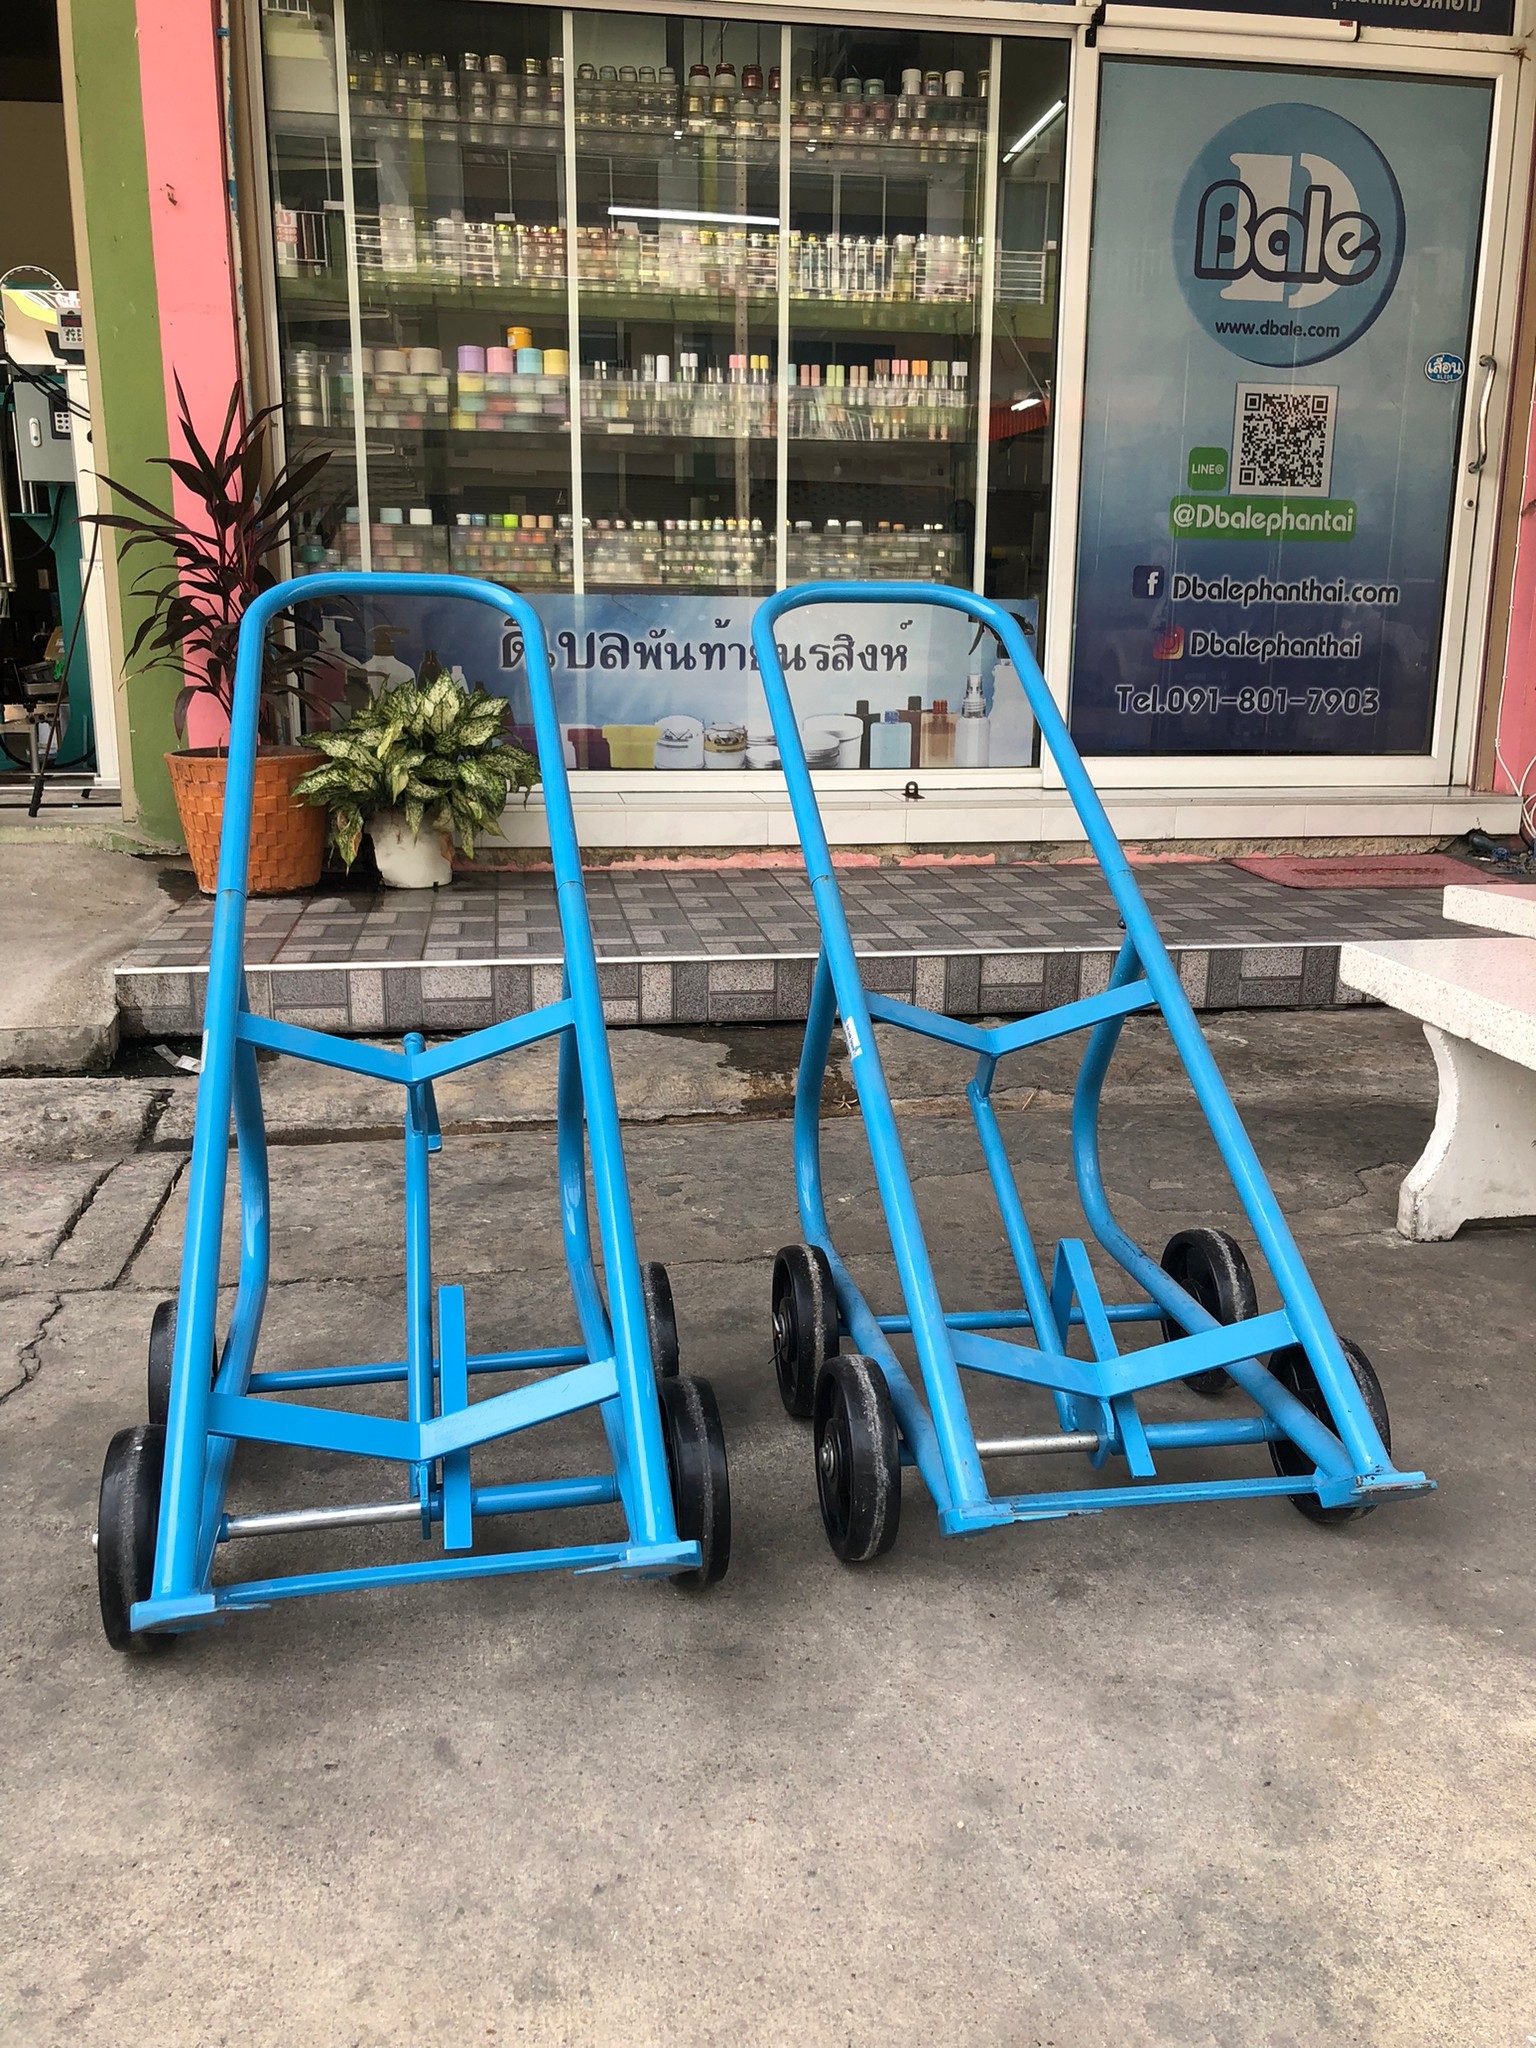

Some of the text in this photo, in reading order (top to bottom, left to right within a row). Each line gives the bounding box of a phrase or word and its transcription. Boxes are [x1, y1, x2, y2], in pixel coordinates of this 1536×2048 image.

[1194, 179, 1382, 287] Bale
[1215, 319, 1340, 339] www.dbale.com
[1427, 354, 1462, 375] เลื่อน
[1191, 463, 1225, 475] LINE@
[1173, 503, 1354, 536] @Dbalephantai
[1172, 575, 1399, 608] Dbalephanthai.com
[1190, 631, 1362, 662] Dbalephanthai
[1116, 685, 1380, 714] Tel.091-801-7903
